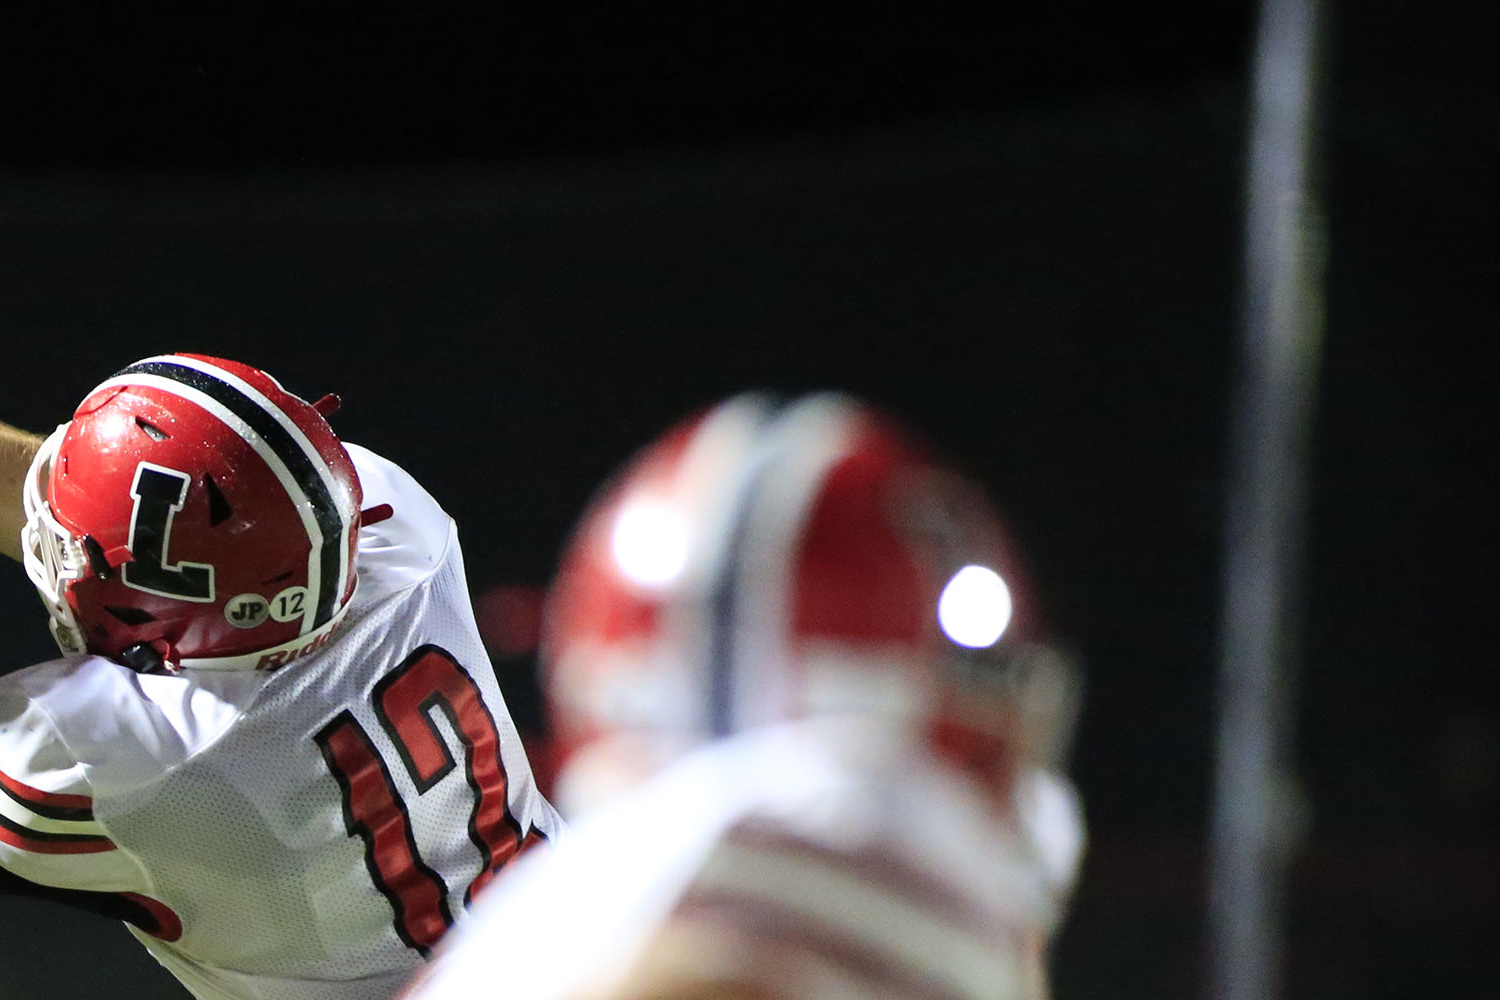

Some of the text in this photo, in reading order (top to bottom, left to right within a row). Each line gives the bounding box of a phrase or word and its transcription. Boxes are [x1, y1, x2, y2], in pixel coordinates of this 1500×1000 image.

[121, 461, 216, 603] L
[231, 601, 263, 621] JP
[278, 591, 305, 617] 12
[312, 643, 549, 960] 12
